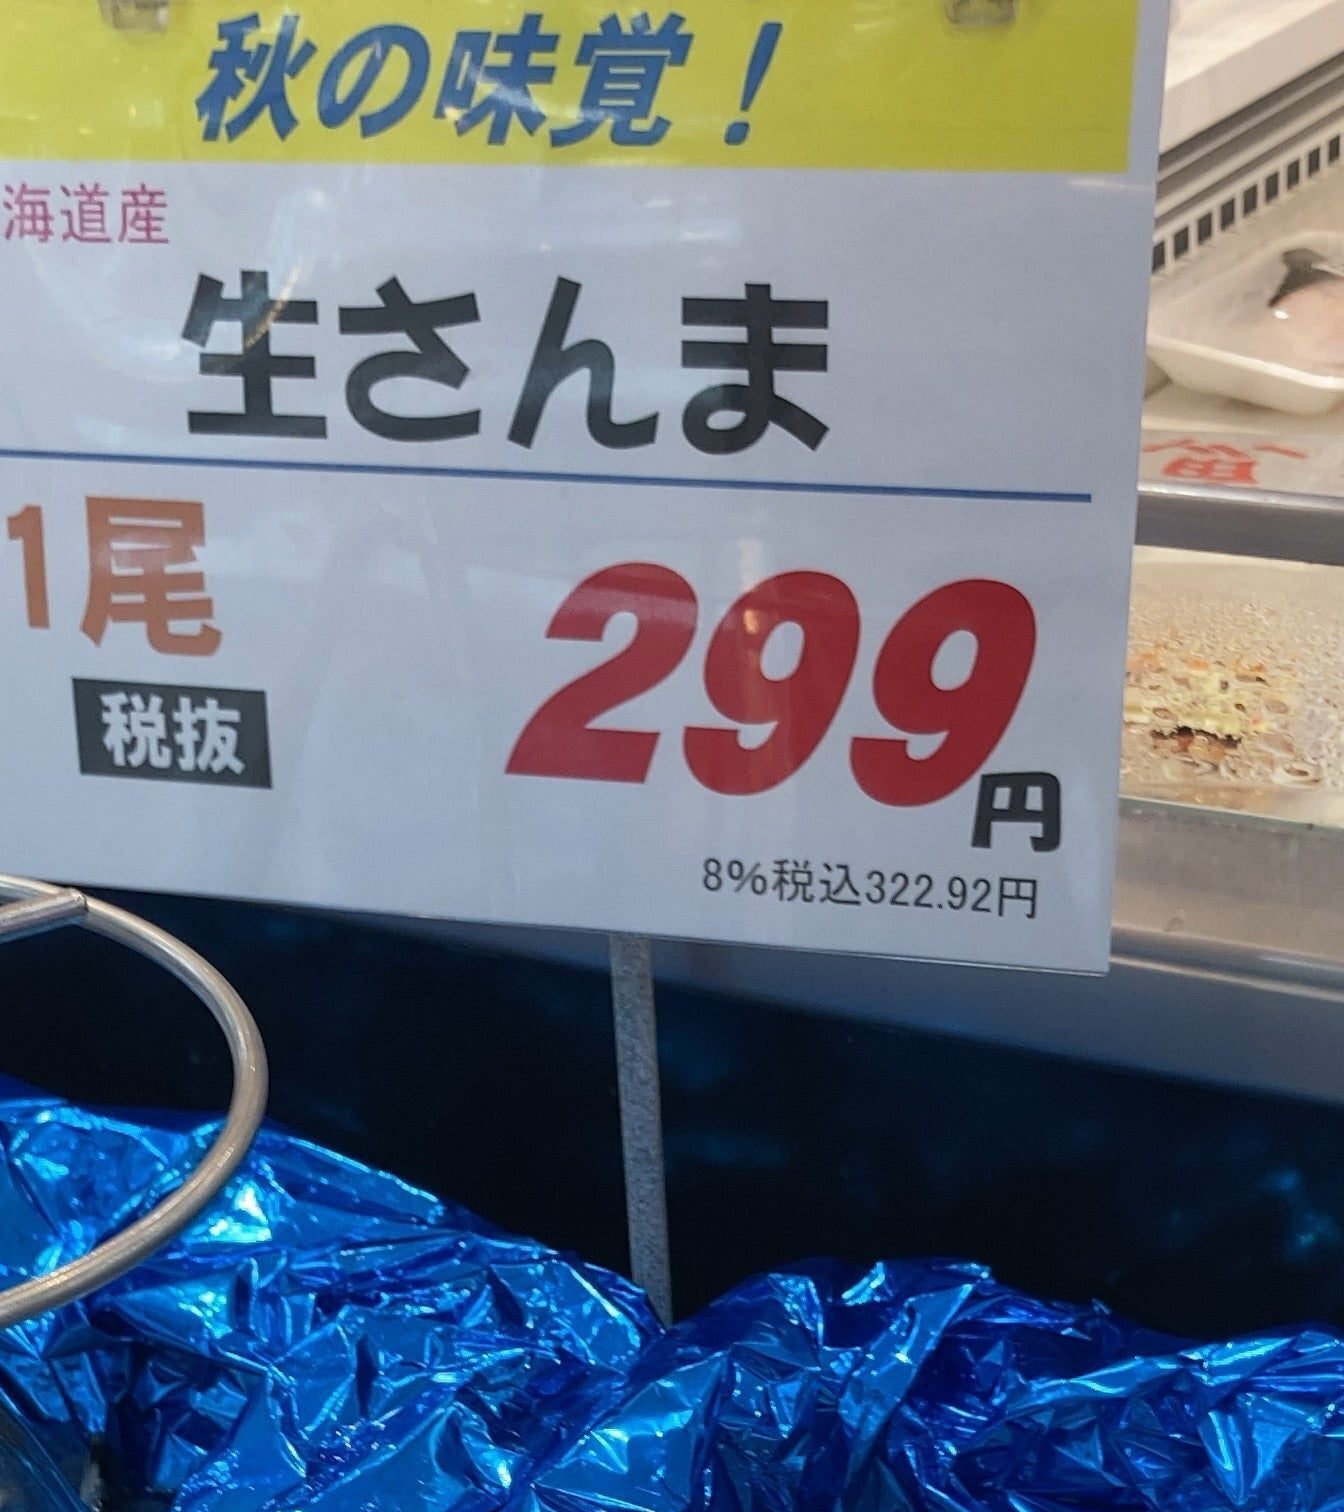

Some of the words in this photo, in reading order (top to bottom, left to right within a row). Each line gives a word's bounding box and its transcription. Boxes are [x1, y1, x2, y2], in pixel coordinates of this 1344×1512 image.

[196, 12, 784, 149] 秋の味覚！
[181, 269, 830, 455] 生さんま
[6, 495, 224, 657] 1尾
[99, 691, 246, 775] 税抜
[702, 857, 1039, 920] 8%税込322.92円
